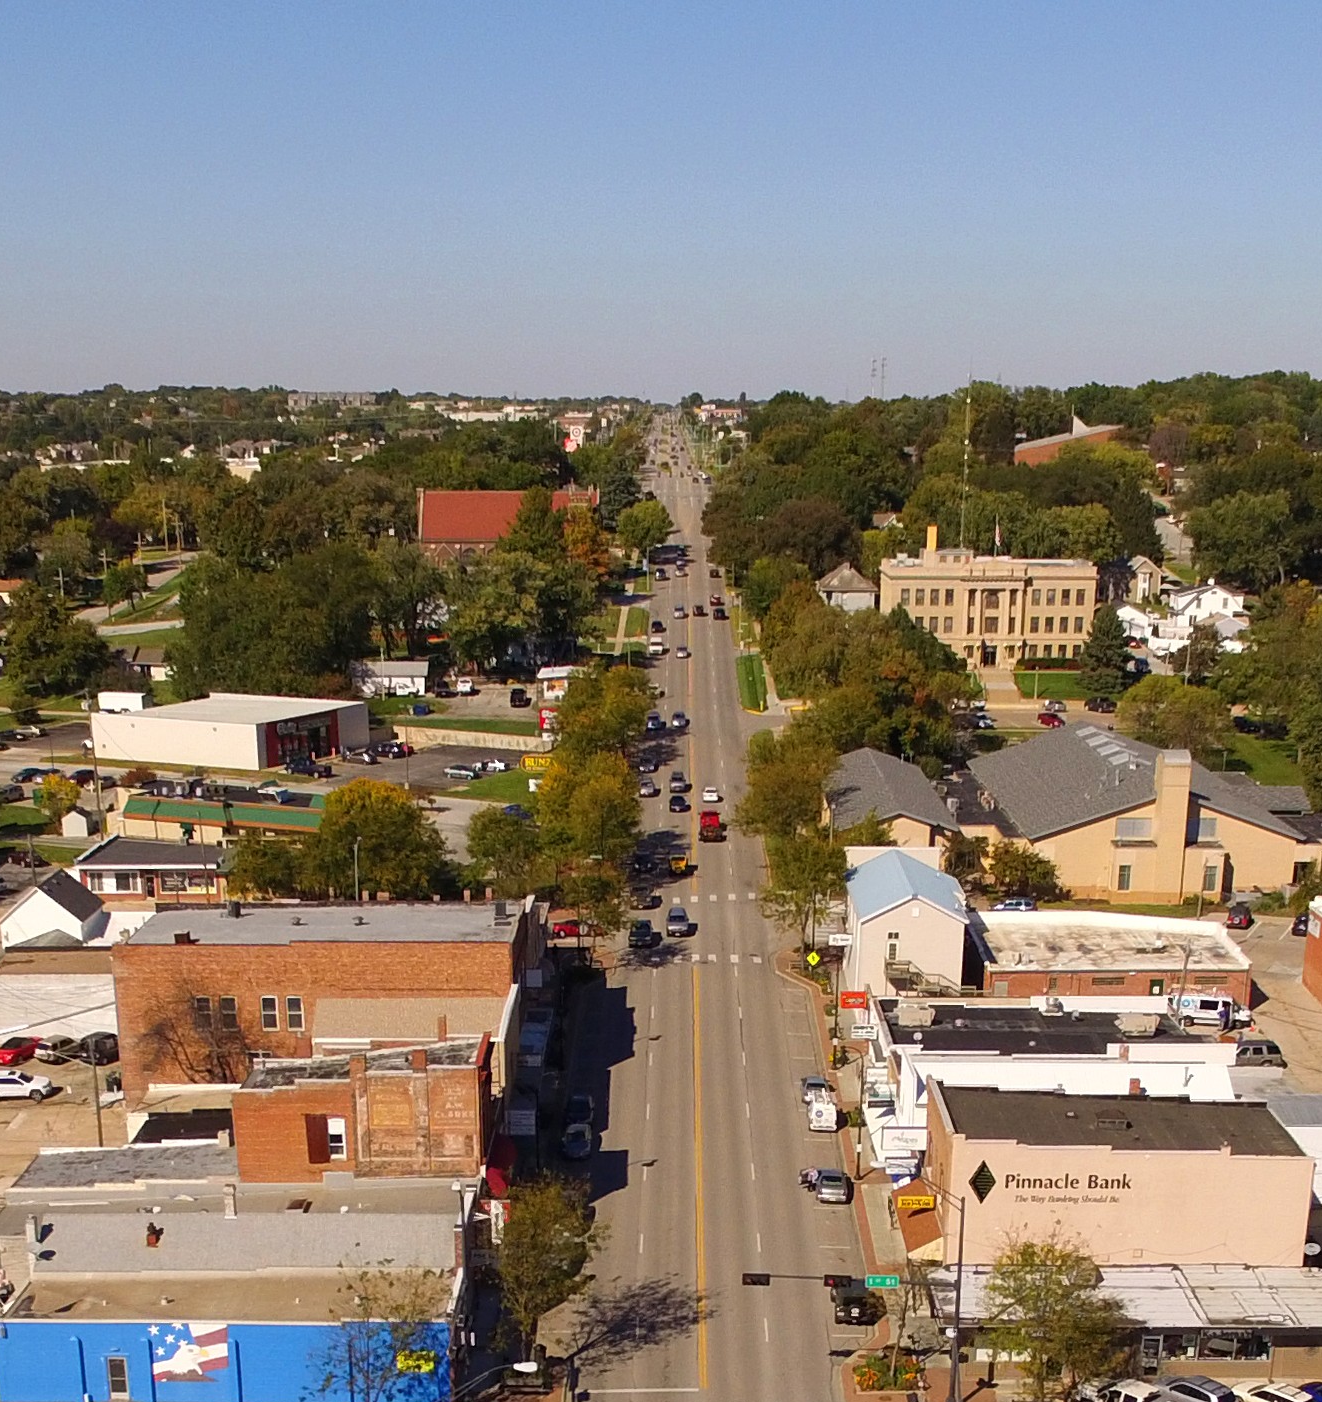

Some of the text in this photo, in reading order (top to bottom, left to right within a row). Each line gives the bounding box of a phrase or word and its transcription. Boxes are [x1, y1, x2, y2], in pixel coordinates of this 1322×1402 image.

[1004, 1173, 1132, 1190] Pinnacle Bank
[1014, 1194, 1028, 1203] The
[1030, 1194, 1046, 1204] Way
